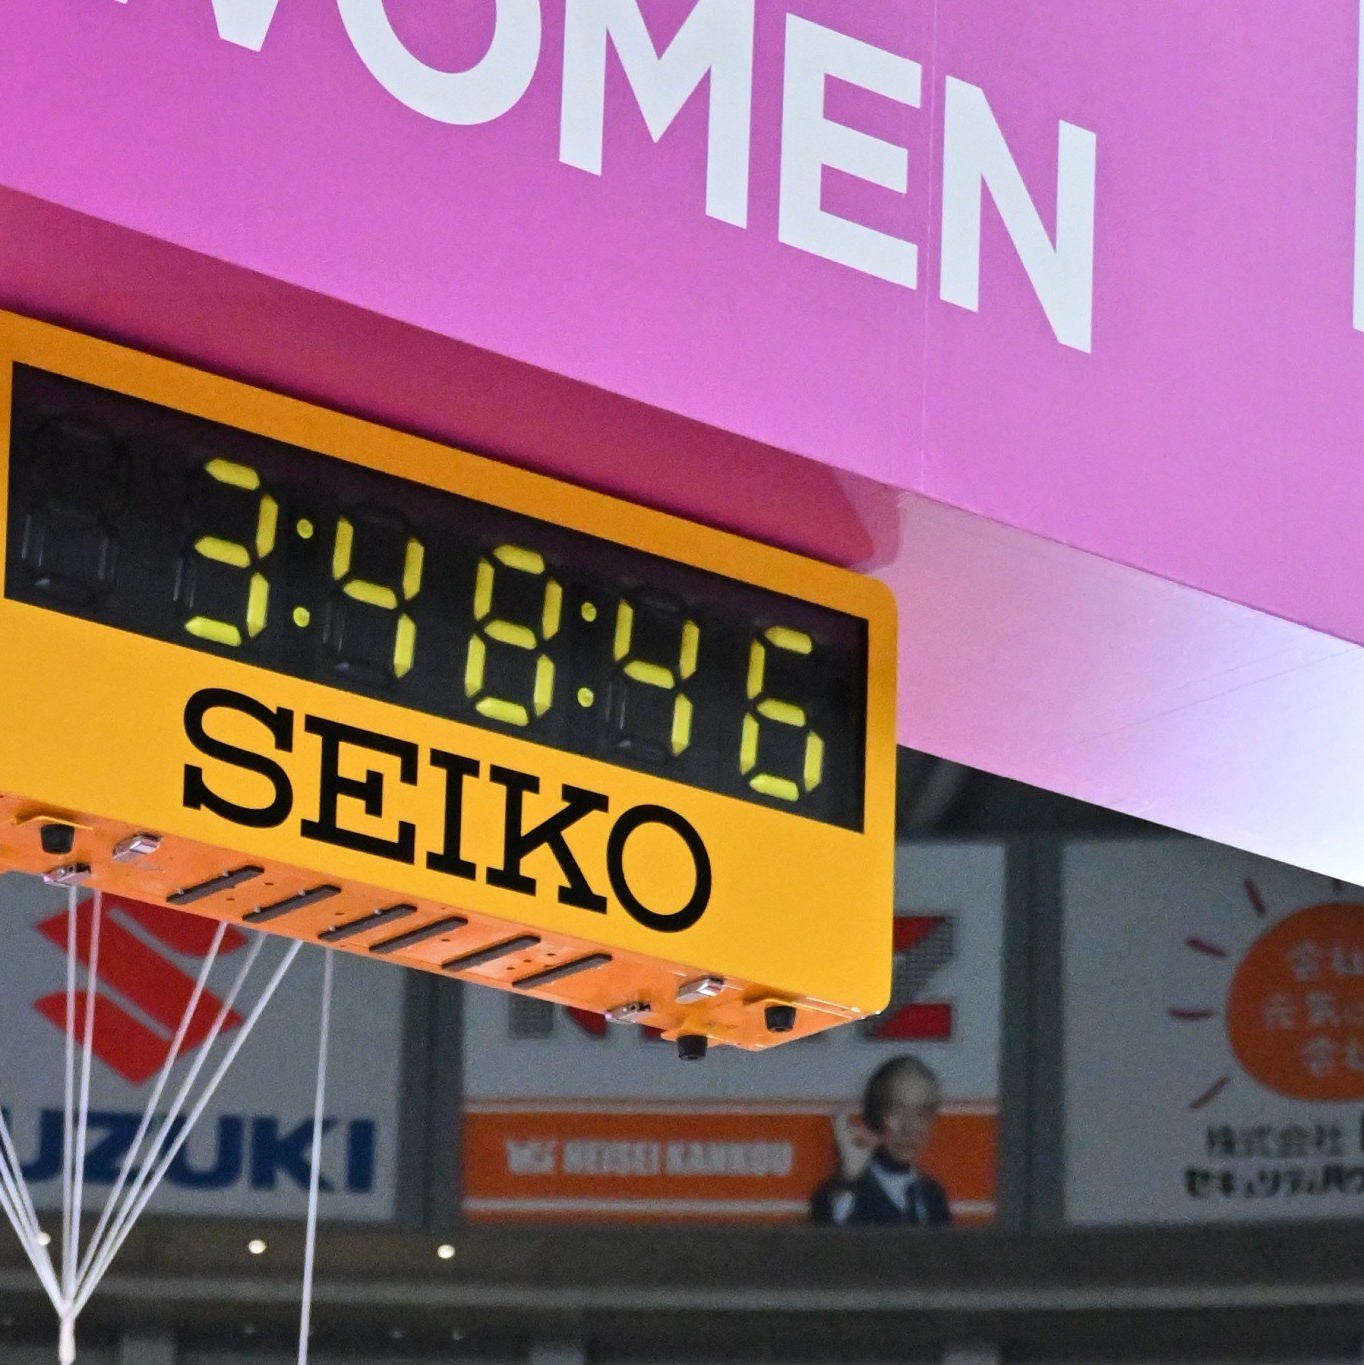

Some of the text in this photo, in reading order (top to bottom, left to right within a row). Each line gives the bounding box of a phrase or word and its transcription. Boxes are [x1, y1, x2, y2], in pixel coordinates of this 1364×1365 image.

[112, 0, 1097, 355] OMEN
[185, 457, 824, 802] 3:48:46
[182, 687, 712, 933] SEIKO
